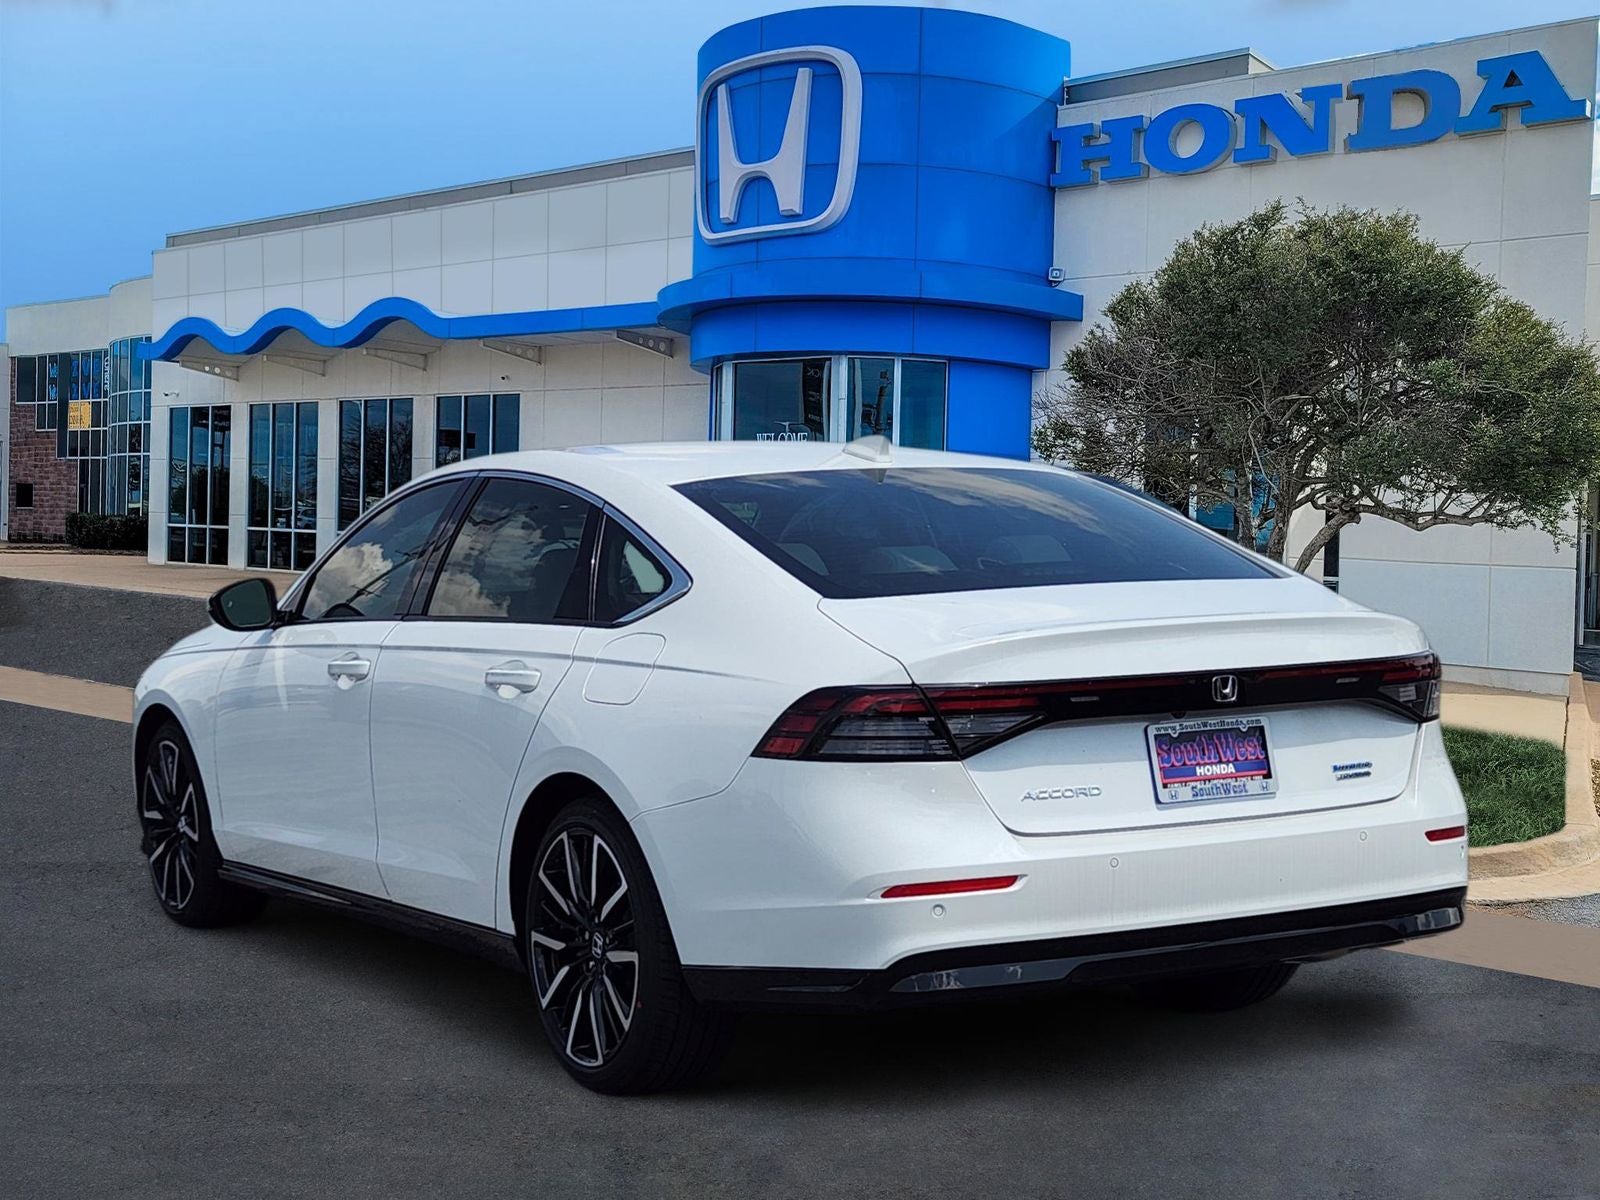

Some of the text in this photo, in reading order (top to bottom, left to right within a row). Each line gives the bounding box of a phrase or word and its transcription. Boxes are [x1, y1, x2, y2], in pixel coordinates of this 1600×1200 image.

[1050, 50, 1591, 188] HONDA
[1195, 763, 1236, 776] HONDA
[1020, 786, 1102, 802] ACCORD
[1191, 781, 1249, 798] SouthWest
